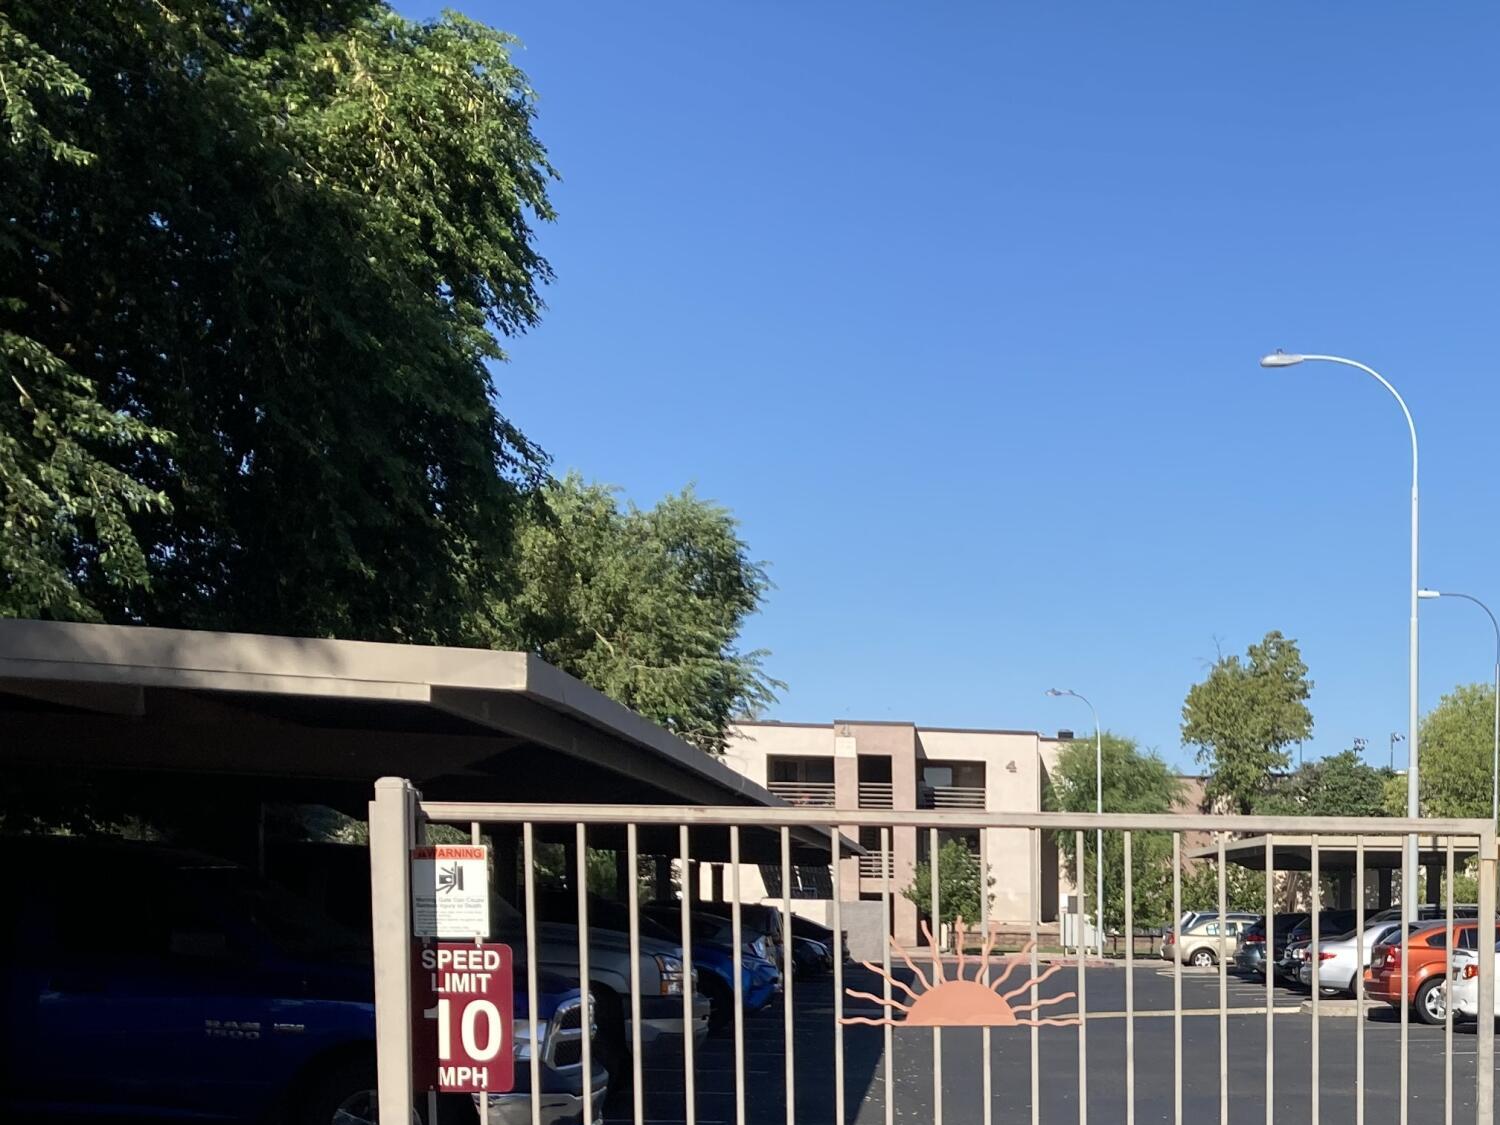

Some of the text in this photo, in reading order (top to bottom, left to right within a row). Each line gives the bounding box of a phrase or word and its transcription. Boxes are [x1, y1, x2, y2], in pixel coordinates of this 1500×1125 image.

[425, 848, 482, 858] WARNING
[421, 950, 500, 970] SPEED
[431, 973, 492, 993] LIMIT
[423, 999, 502, 1061] 10
[438, 1066, 489, 1087] MPH
